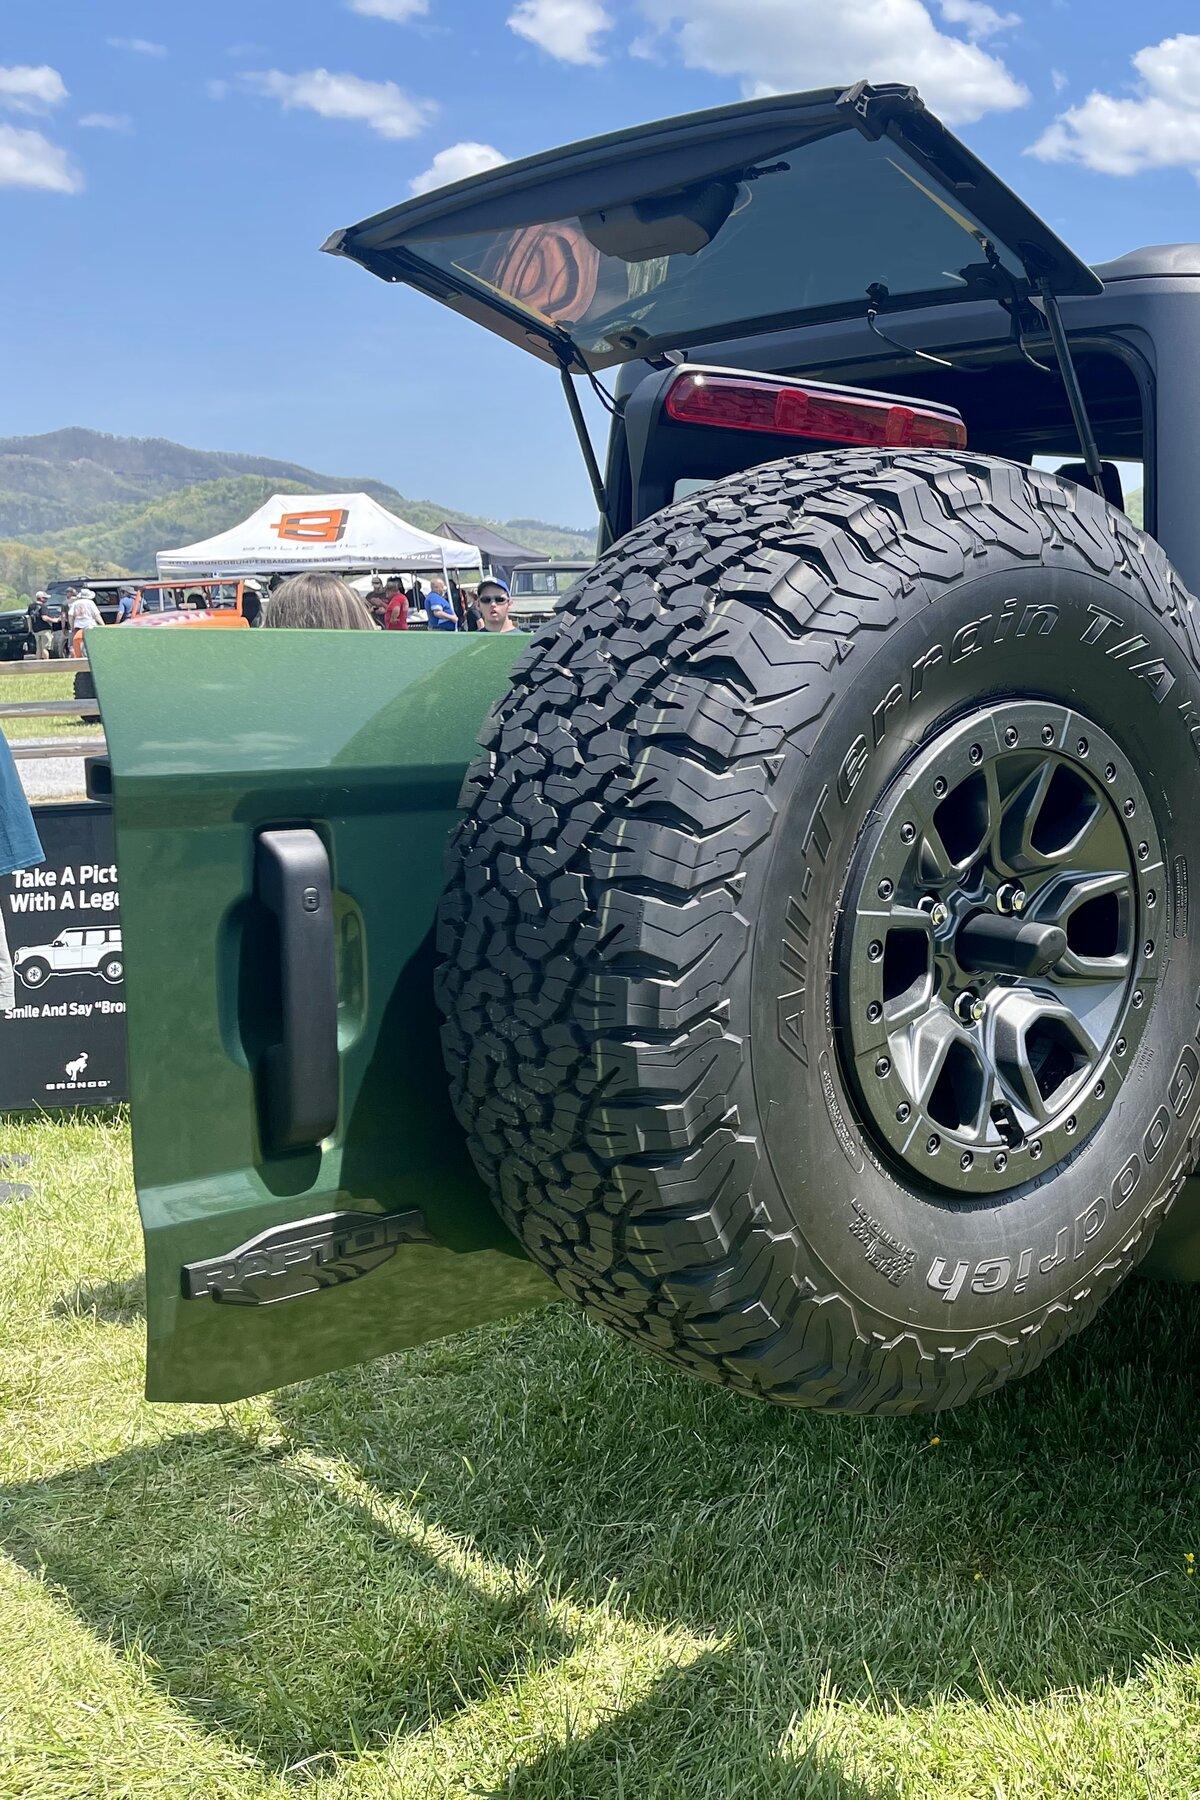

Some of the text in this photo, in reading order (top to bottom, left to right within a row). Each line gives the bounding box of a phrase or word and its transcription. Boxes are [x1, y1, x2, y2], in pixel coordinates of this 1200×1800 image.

[777, 598, 1061, 1067] All-Terrain
[1078, 603, 1177, 704] T/A
[11, 863, 118, 888] Take A Pict
[10, 891, 56, 913] With
[59, 891, 76, 911] A
[5, 1002, 39, 1019] Smile
[41, 1001, 67, 1017] And
[69, 1001, 93, 1018] Say
[45, 1080, 108, 1090] BRONCO
